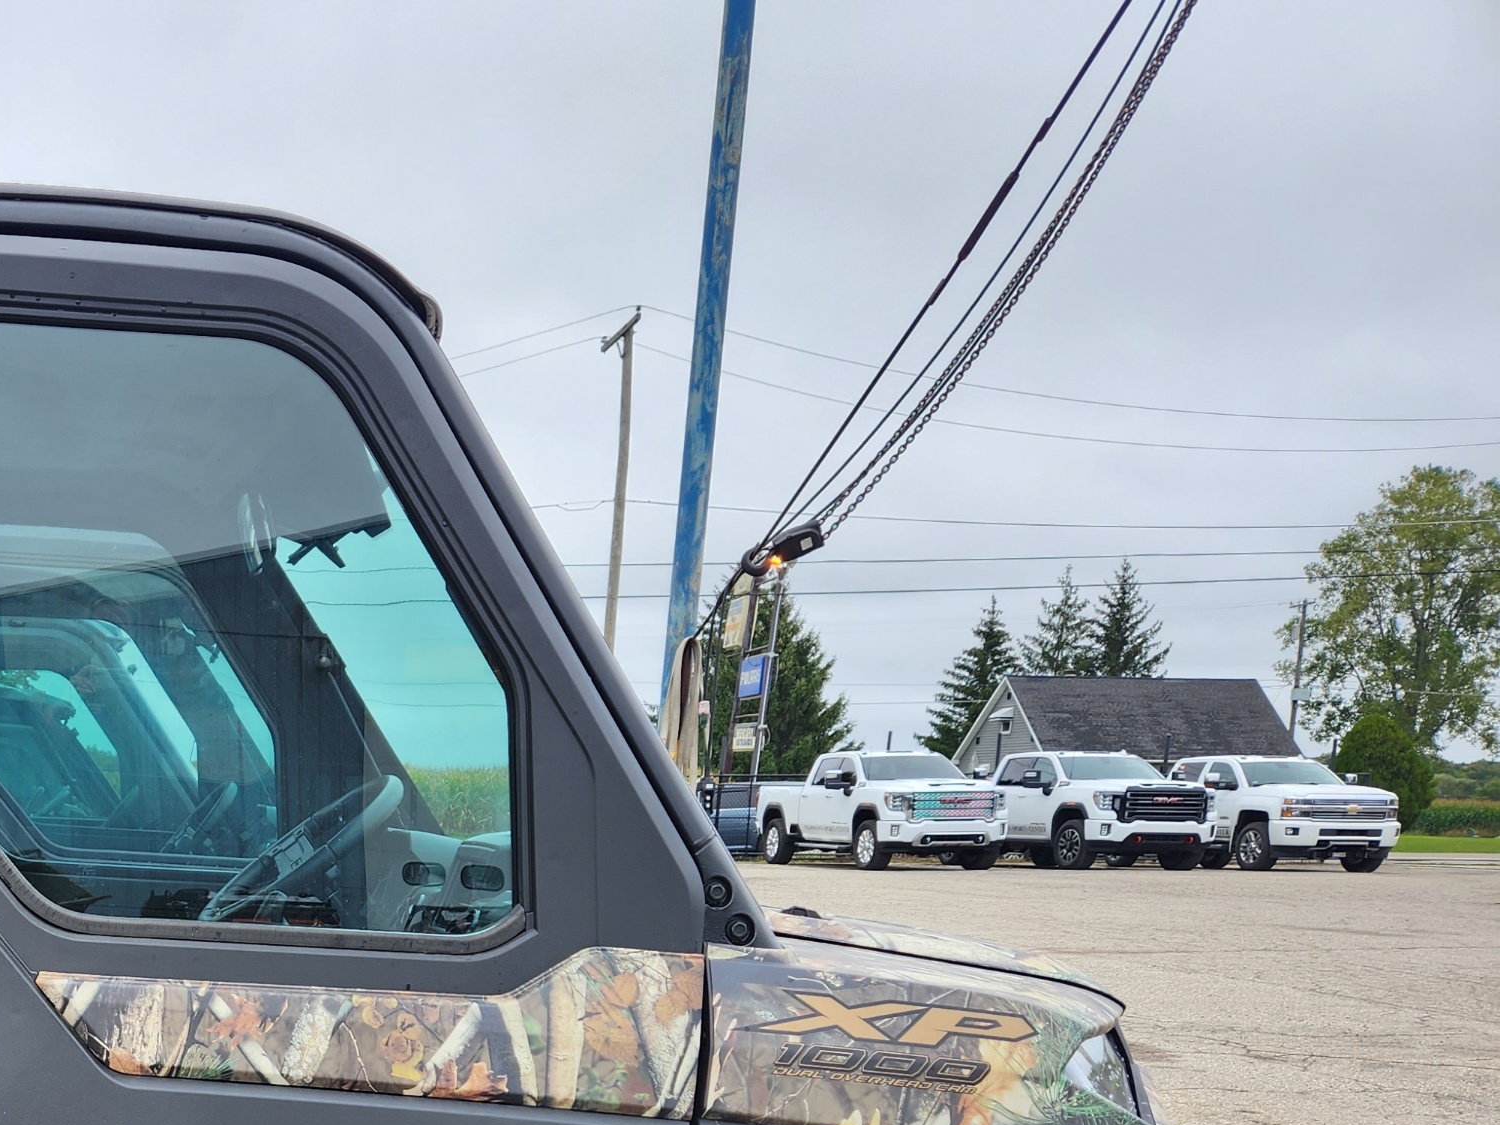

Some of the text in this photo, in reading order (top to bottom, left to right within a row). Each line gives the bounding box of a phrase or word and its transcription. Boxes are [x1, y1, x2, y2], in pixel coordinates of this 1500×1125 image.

[1153, 796, 1184, 804] GMC
[738, 988, 1038, 1047] XP
[772, 1067, 978, 1095] DUAL OVERHEAD CAM
[774, 1041, 991, 1085] 1000
